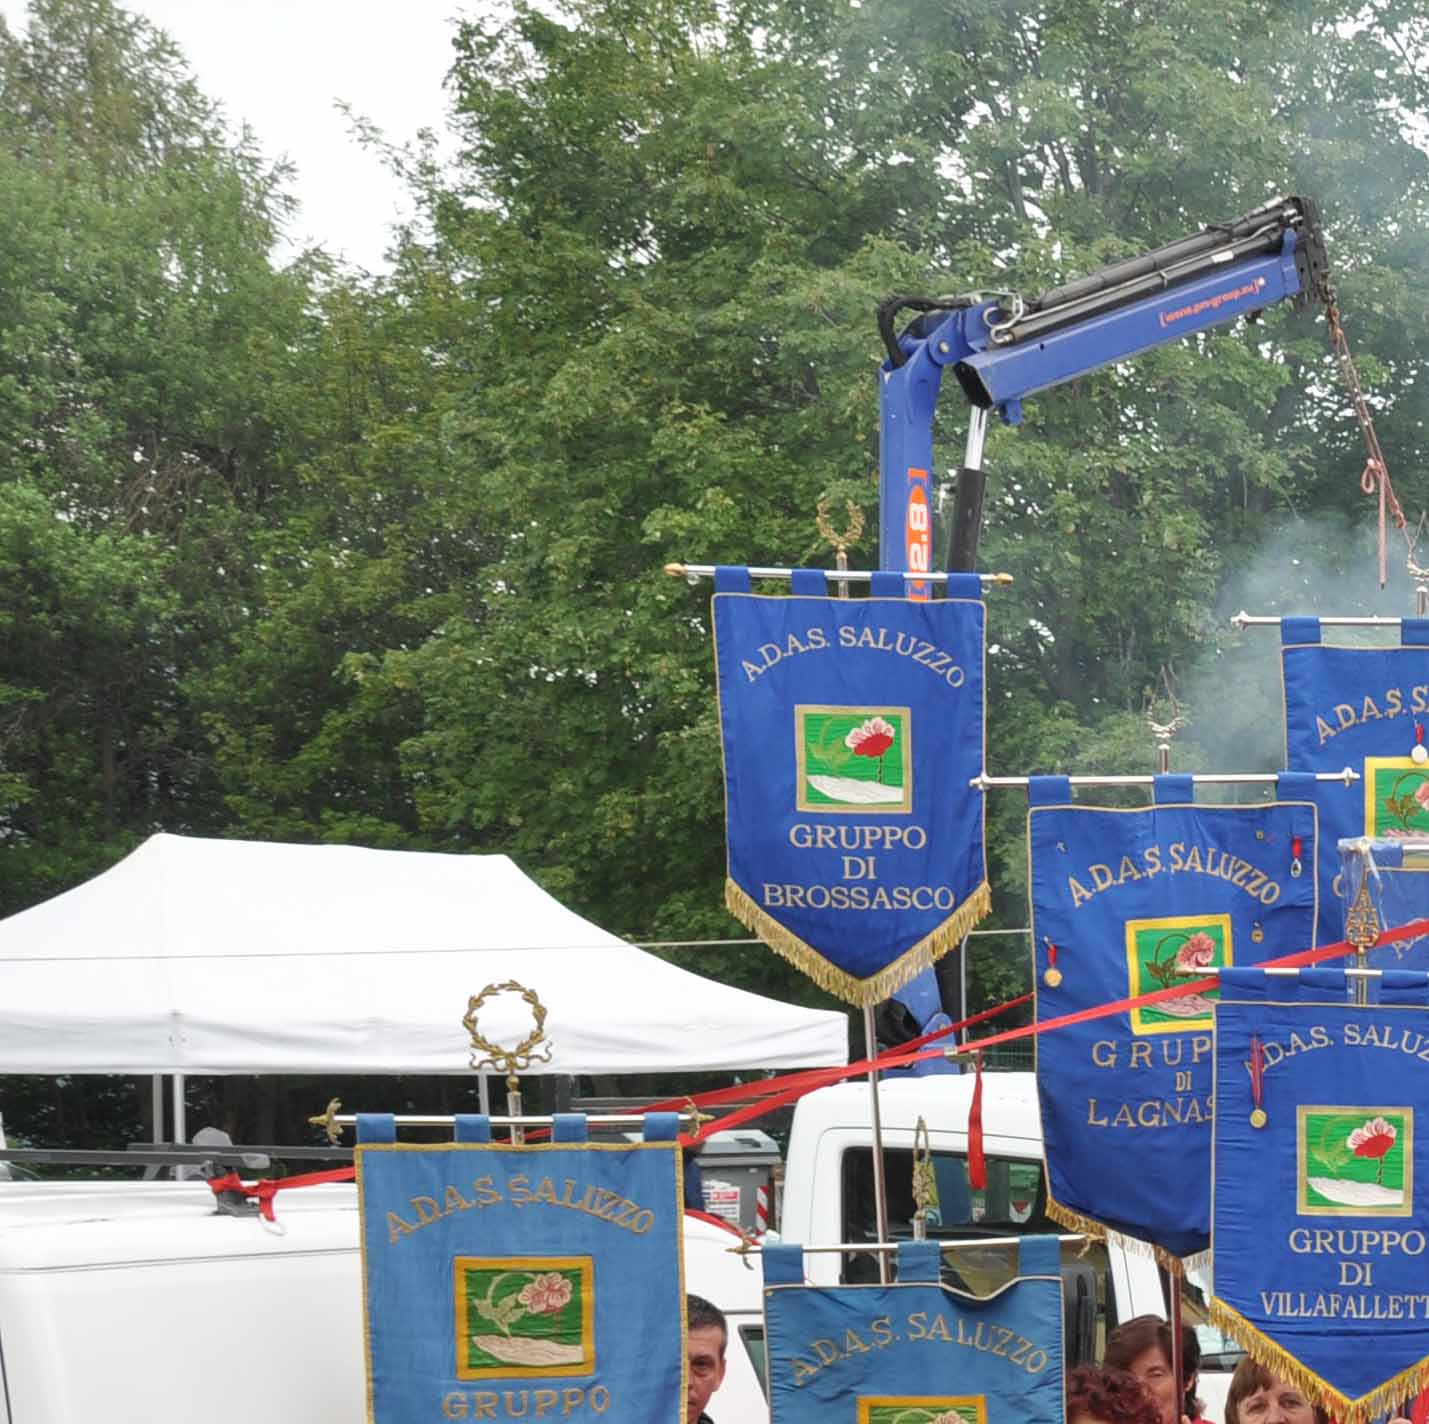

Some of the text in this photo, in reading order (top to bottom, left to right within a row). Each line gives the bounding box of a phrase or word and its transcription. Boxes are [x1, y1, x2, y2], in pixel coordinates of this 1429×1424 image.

[839, 626, 965, 688] SALUZZO
[789, 823, 927, 850] GRUPPO
[842, 856, 877, 880] DI
[1169, 842, 1281, 905] SALUZZO
[763, 884, 955, 910] BROSSASCO
[1092, 1037, 1212, 1068] GRUP
[1176, 1071, 1193, 1092] DI
[508, 1173, 656, 1234] SALUZZO
[1288, 1229, 1426, 1255] GRUPPO
[1339, 1261, 1373, 1286] DI
[907, 1311, 1047, 1374] SALUZZO
[442, 1386, 610, 1419] GRUPPO
